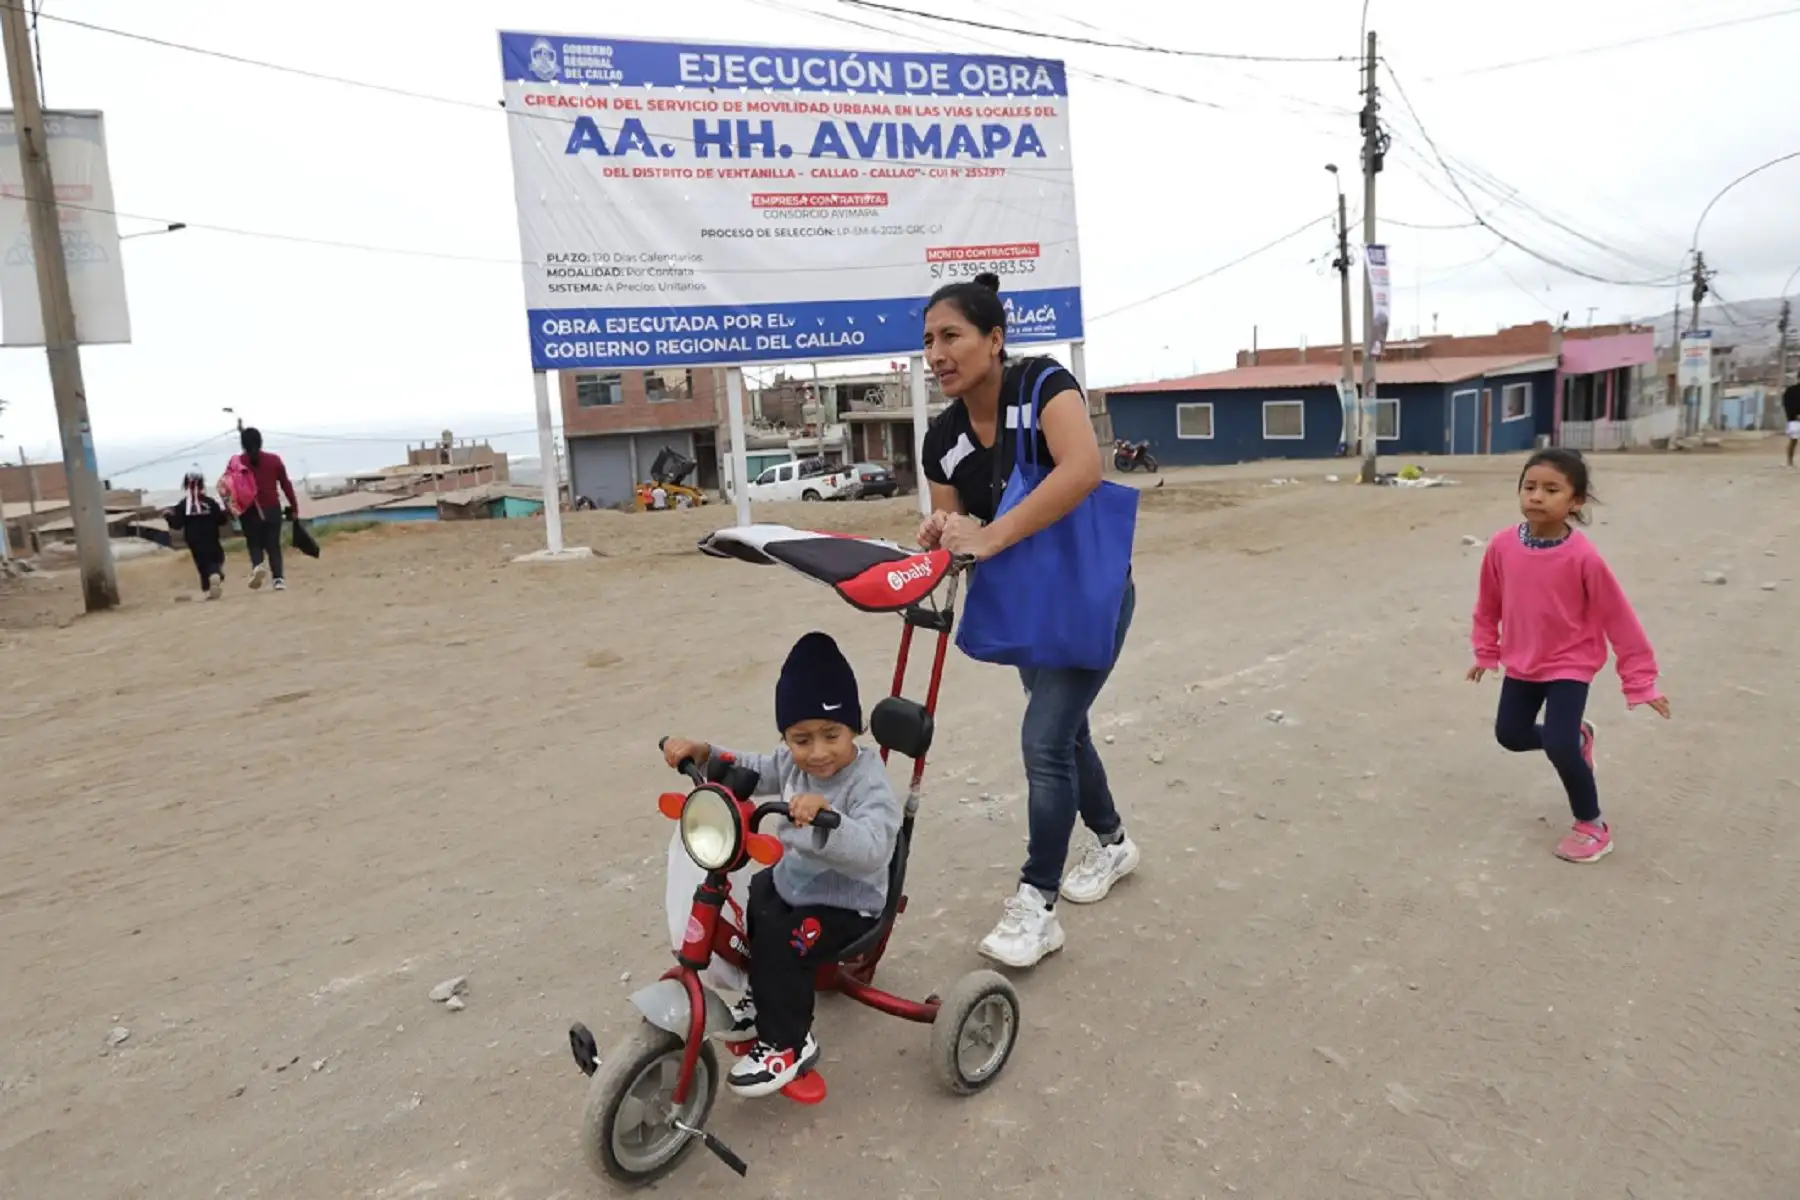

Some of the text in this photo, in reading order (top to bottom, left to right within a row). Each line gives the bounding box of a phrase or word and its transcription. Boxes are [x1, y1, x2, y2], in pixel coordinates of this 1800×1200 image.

[562, 43, 614, 56] GOBIERNO
[564, 68, 624, 81] DEL CALLAO
[679, 53, 1054, 91] EJECUCIÓN DE OBRA
[524, 93, 608, 110] CREACIÓN
[613, 98, 641, 110] DEL
[647, 99, 716, 112] SERVICIO
[723, 101, 742, 112] DE
[747, 101, 830, 114] MOVILIDAD
[833, 103, 892, 115] URBANA
[895, 104, 911, 115] EN
[916, 105, 940, 117] LAS
[976, 106, 1031, 118] LOCALES
[1035, 106, 1057, 117] DEL
[564, 115, 1047, 160] AA. HH. AVIMAPA
[603, 167, 629, 178] DEL
[632, 167, 693, 179] DISTRITO
[697, 168, 713, 179] DE
[718, 168, 795, 179] VENTANILLA
[810, 168, 860, 179] CALLAO
[929, 168, 948, 178] CUI
[753, 194, 808, 206] EMPRESA
[763, 208, 879, 220] CONSORCIO AVIMAPA
[701, 228, 754, 238] PROCESO
[757, 228, 771, 238] DE
[774, 226, 835, 238] SELECCIÓN:
[546, 252, 590, 263] PLAZO:
[928, 248, 965, 260] MONTO
[546, 266, 694, 278] MODALIDAD: Por Contrata
[930, 262, 944, 279] S/
[548, 281, 707, 293] SISTEMA: A Precios Unitarios
[542, 313, 789, 336] OBRA EJECUTADA POR EL
[544, 331, 865, 359] GOBIERNO REGIONAL DEL CALLAO
